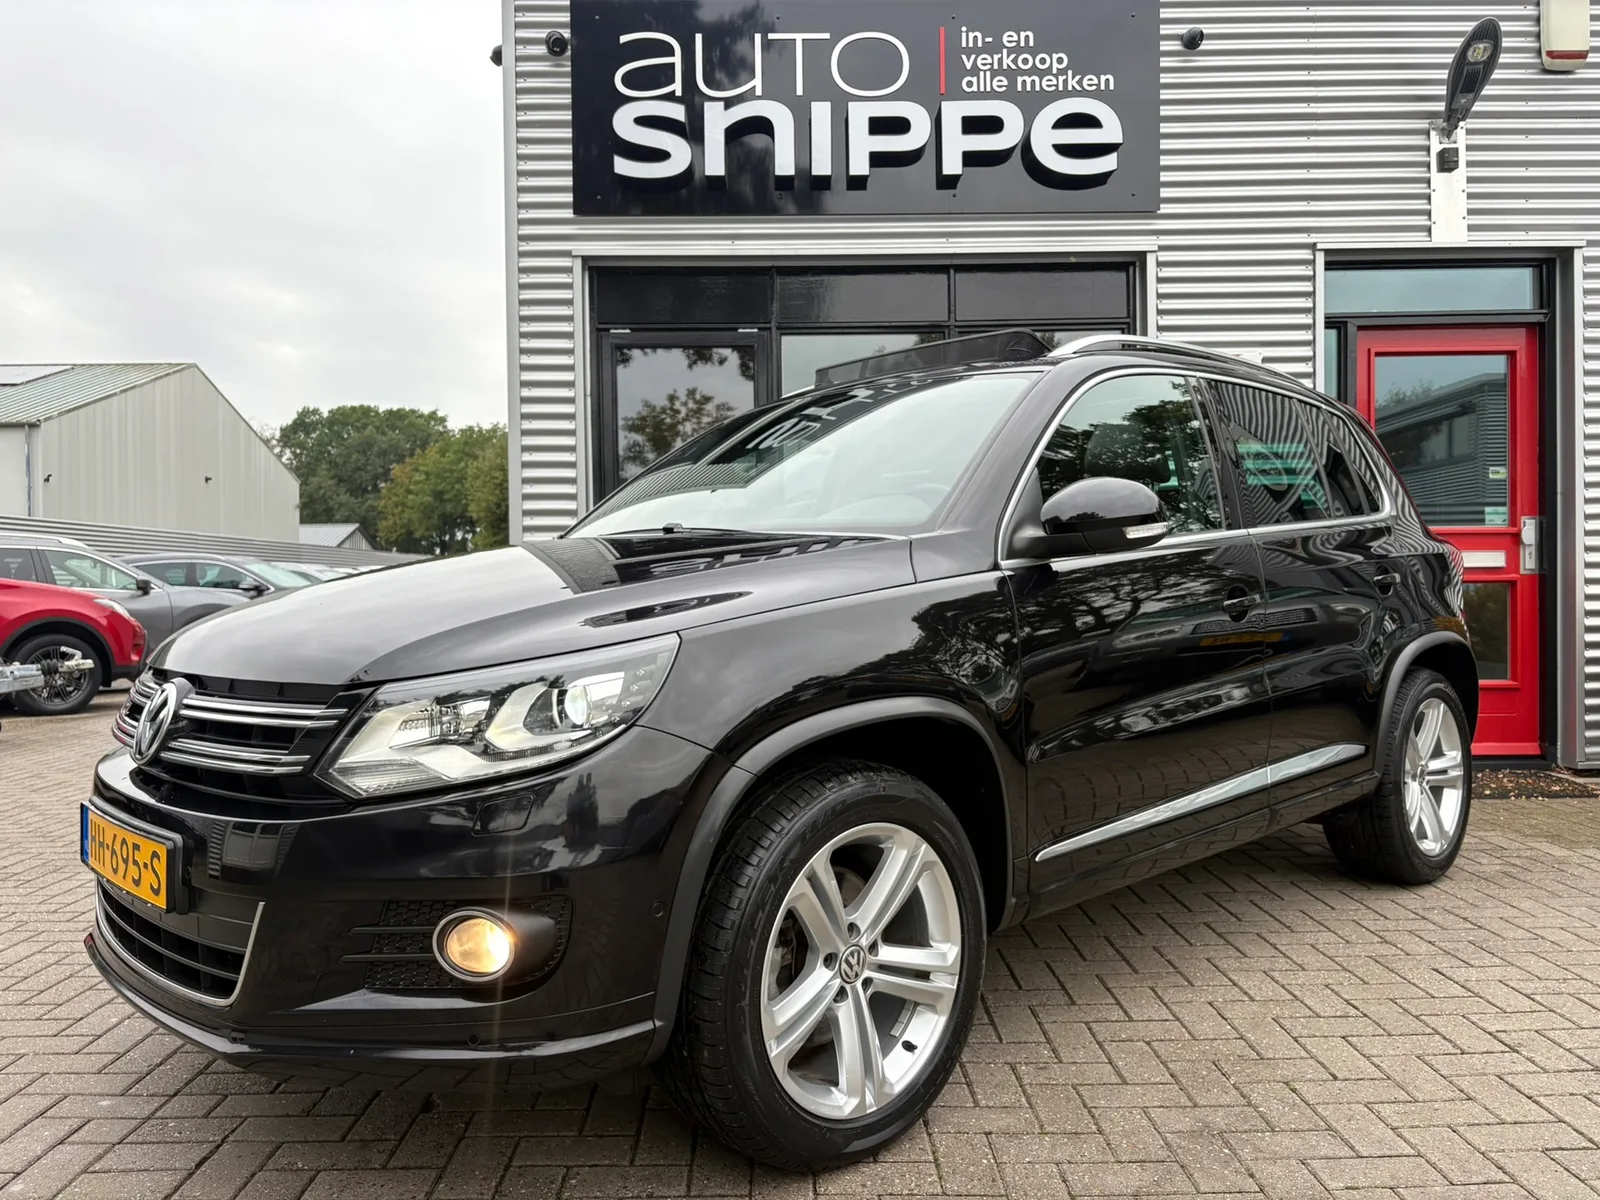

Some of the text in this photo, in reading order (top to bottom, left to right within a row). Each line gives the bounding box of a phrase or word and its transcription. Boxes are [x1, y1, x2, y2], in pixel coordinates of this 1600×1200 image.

[960, 26, 1034, 48] in- en
[960, 49, 1069, 74] verkoop
[961, 70, 1115, 93] alle merken
[90, 817, 161, 897] HH-695-S
